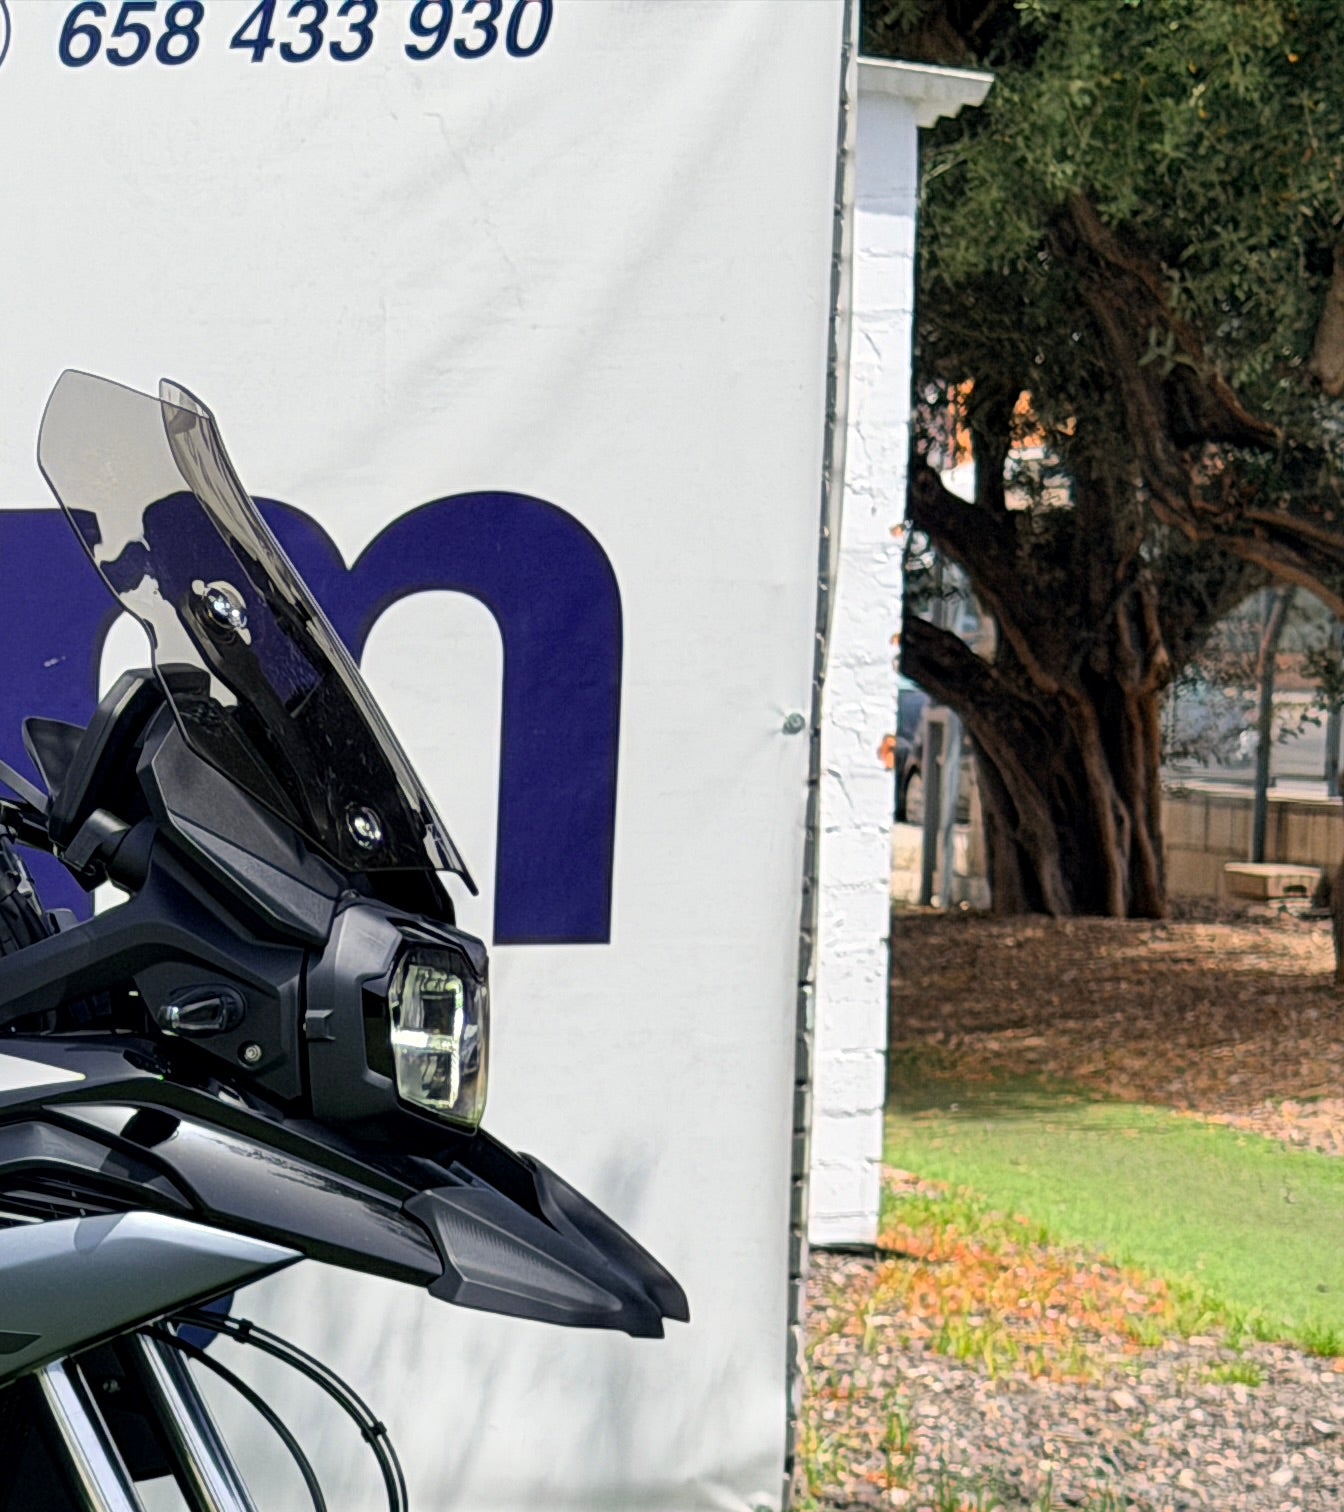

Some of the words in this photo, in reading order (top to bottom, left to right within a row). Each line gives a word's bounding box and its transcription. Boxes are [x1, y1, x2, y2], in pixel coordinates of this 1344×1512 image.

[58, 0, 205, 67] 658
[229, 0, 379, 63] 433
[404, 0, 554, 61] 930
